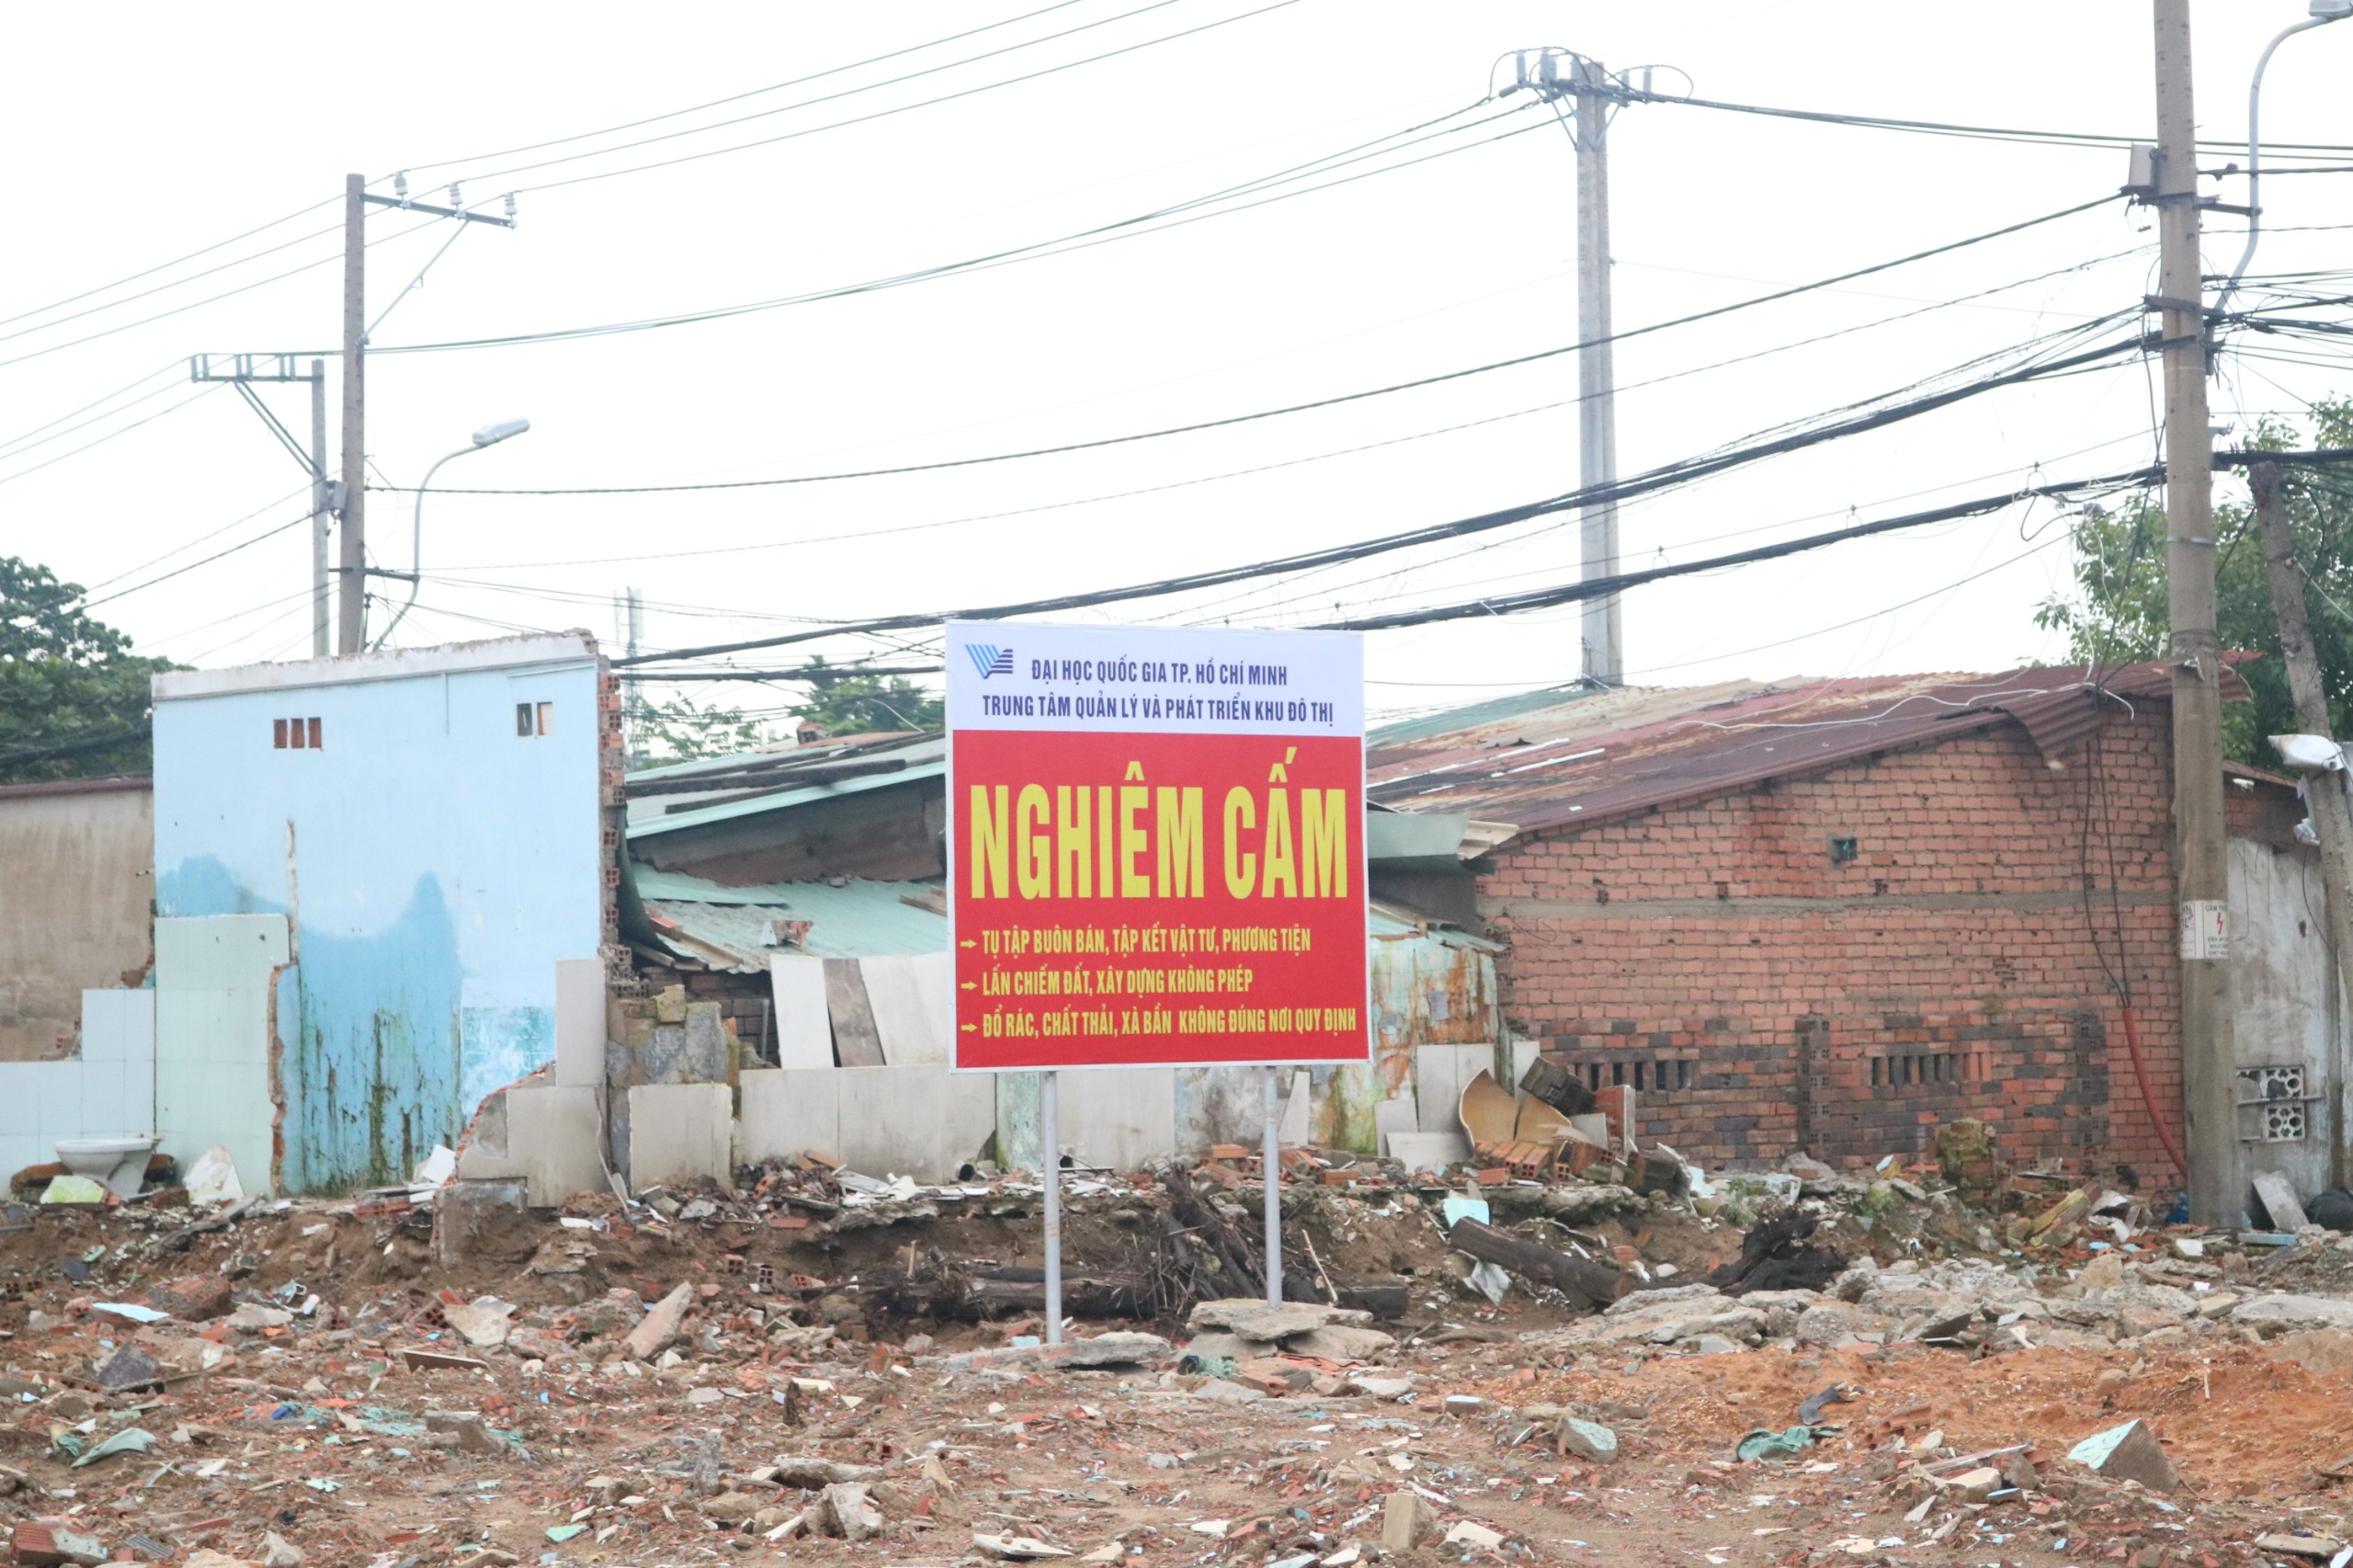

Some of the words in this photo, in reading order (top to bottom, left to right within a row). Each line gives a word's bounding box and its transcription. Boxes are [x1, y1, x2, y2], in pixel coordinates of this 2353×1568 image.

[1031, 659, 1058, 686] ĐẠI
[1062, 660, 1093, 686] HỌC
[1097, 653, 1138, 684] QUỐC
[1142, 661, 1167, 683] GIA
[1171, 662, 1192, 684] TP.
[1196, 656, 1215, 685] HỒ
[1219, 660, 1245, 686] CHÍ
[1248, 665, 1288, 687] MINH
[982, 694, 1034, 717] TRUNG
[1038, 691, 1071, 717] TÂM
[1075, 689, 1117, 720] QUẢN
[1120, 693, 1139, 719] LÝ
[1142, 693, 1162, 720] VÀ
[1165, 694, 1204, 720] PHÁT
[1207, 691, 1251, 721] TRIỂN
[1255, 700, 1284, 722] KHU
[1287, 697, 1307, 722] ĐÔ
[1310, 701, 1334, 728] THỊ
[970, 760, 1205, 901] NGHIÊM
[1223, 746, 1348, 901] CẤM
[982, 930, 1000, 960] TỤ
[1003, 925, 1030, 960] TẬP
[1033, 924, 1073, 954] BUÔN
[1075, 924, 1109, 956] BÁN,
[1112, 924, 1139, 958] TẬP
[1142, 921, 1167, 953] KẾT
[1170, 923, 1195, 958] VẬT
[1199, 926, 1220, 955] TƯ,
[1222, 926, 1278, 952] PHƯƠNG
[1280, 923, 1311, 957] TIỆN
[983, 962, 1011, 995] LẤN
[1014, 963, 1061, 995] CHIẾM
[1063, 961, 1094, 996] ĐẤT,
[1096, 965, 1124, 994] XÂY
[1126, 967, 1165, 999] DỰNG
[1167, 964, 1215, 994] KHÔNG
[1217, 963, 1254, 993] PHÉP
[983, 1004, 1003, 1038] ĐỔ
[1006, 1007, 1040, 1040] RÁC,
[1042, 1003, 1079, 1037] CHẤT
[1081, 1003, 1119, 1038] THẢI,
[1121, 1006, 1141, 1035] XÀ
[1142, 1002, 1172, 1034] BẦN
[1178, 1005, 1226, 1034] KHÔNG
[1228, 1004, 1266, 1033] ĐÚNG
[1268, 1006, 1292, 1032] NƠI
[1295, 1008, 1322, 1034] QUY
[1324, 1007, 1357, 1037] ĐỊNH
